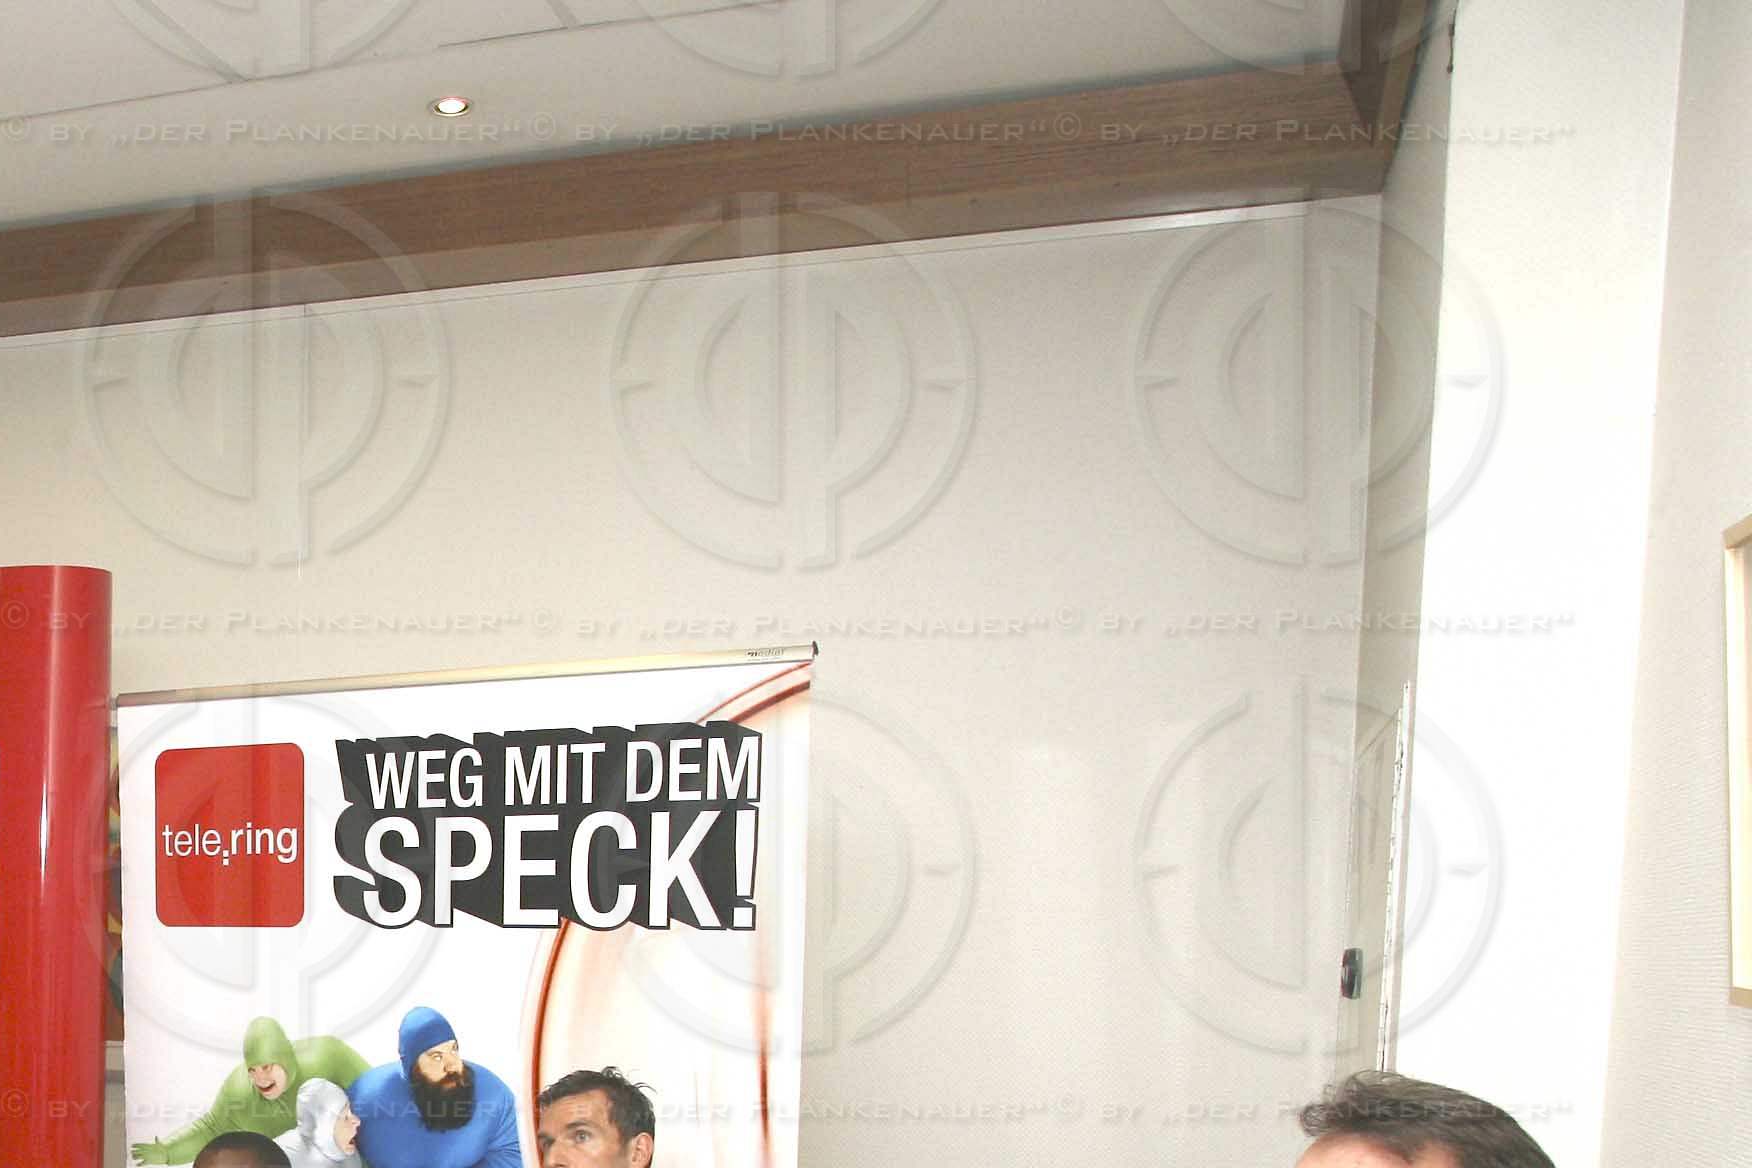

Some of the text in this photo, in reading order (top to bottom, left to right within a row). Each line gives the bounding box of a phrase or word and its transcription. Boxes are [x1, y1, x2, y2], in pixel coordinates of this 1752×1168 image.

[365, 735, 759, 809] WEG MIT DEM
[363, 808, 758, 929] SPECK!
